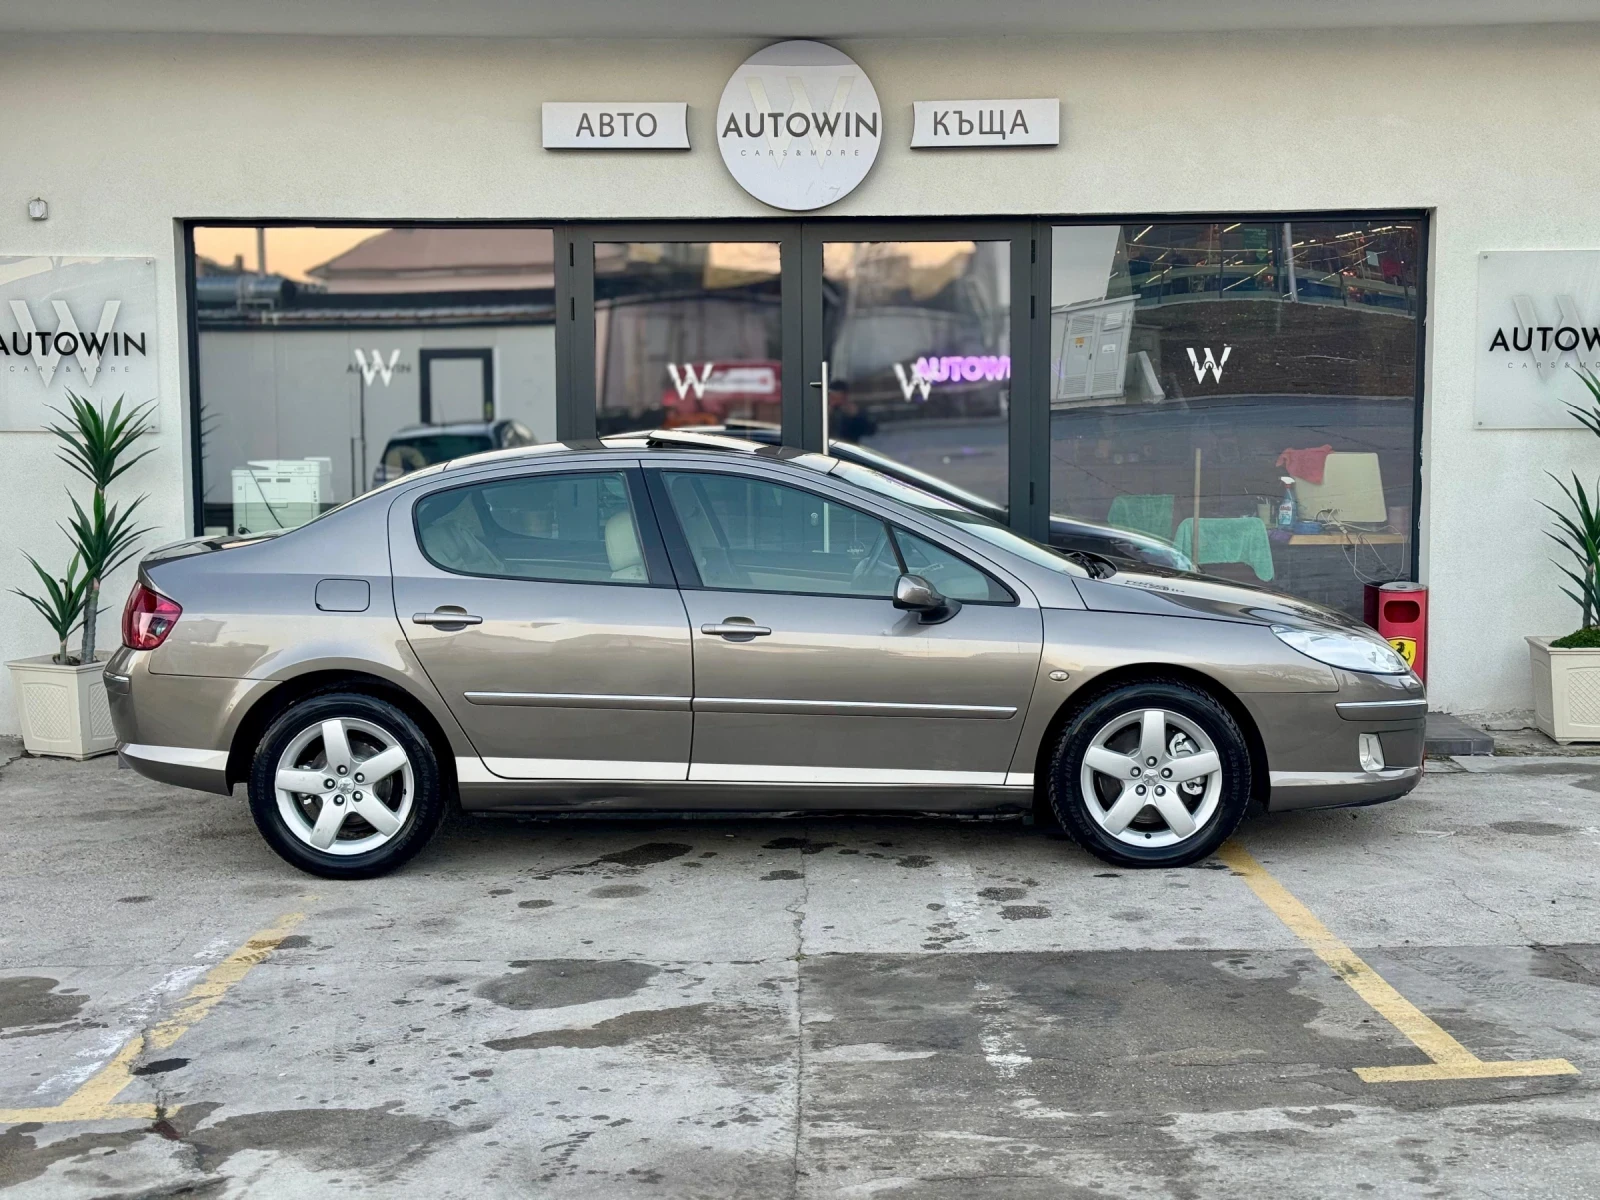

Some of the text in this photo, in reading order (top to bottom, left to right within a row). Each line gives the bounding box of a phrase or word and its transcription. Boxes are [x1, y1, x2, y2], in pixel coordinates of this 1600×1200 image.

[575, 112, 658, 138] АВТО
[722, 111, 878, 139] AUTOWIN
[933, 109, 1029, 140] КЪЩА
[667, 362, 714, 400] W
[1185, 346, 1232, 385] W
